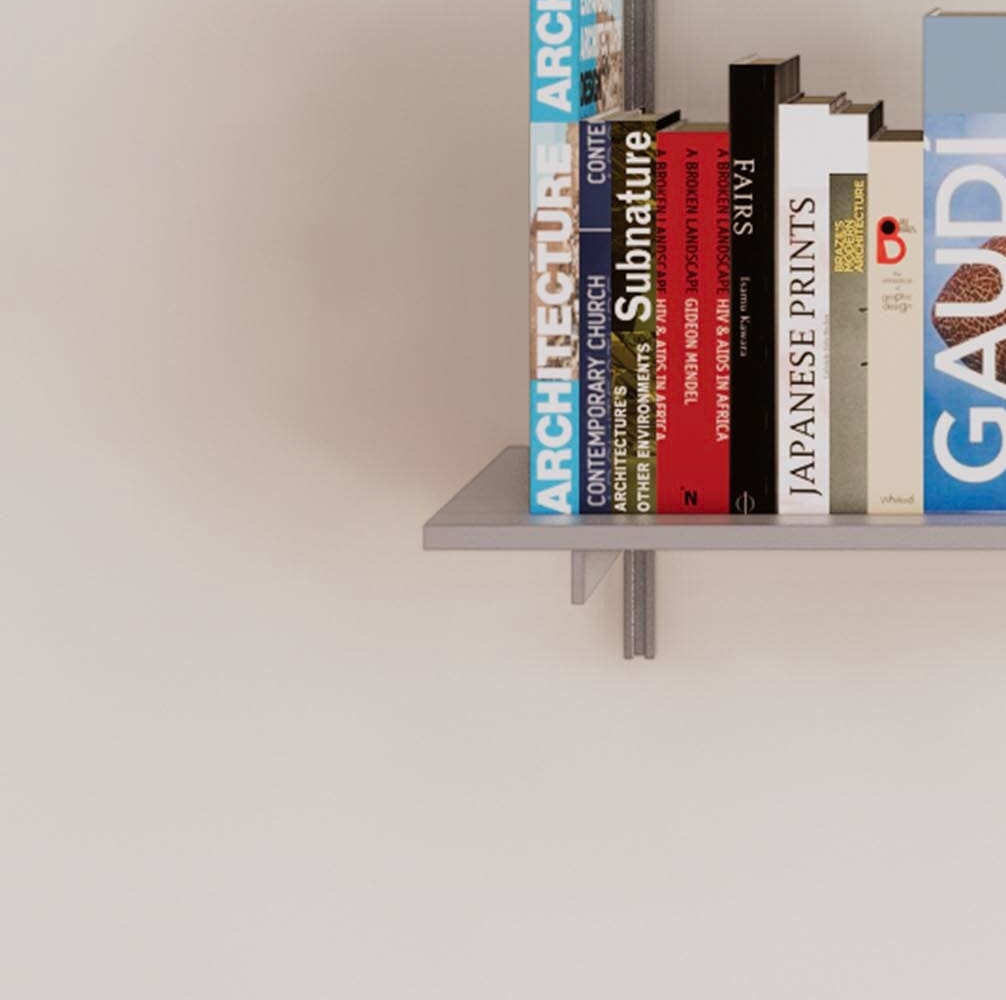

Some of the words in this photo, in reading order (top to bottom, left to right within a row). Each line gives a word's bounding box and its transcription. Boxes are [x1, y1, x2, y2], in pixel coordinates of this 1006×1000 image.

[586, 120, 607, 185] CONTE
[685, 148, 699, 158] A
[716, 148, 730, 158] A
[656, 162, 667, 214] BROKEN
[685, 162, 699, 214] BROKEN
[716, 162, 730, 214] BROKEN
[733, 158, 755, 236] FAIRS
[614, 130, 652, 323] Subnature
[685, 218, 699, 294] LANDSCAPE
[716, 218, 730, 294] LANDSCAPE
[853, 179, 865, 274] ARCHITECTURE
[789, 196, 816, 319] PRINTS
[536, 143, 574, 515] ARCHITECTURE
[586, 274, 606, 350] CHURCH
[684, 298, 699, 349] GIDEON
[716, 299, 730, 323] HIV
[716, 326, 730, 336] &
[684, 352, 699, 406] MENDEL
[716, 340, 730, 372] AIDS
[716, 376, 730, 390] IN
[636, 341, 651, 459] ENVIRONMENTS
[716, 394, 730, 442] AFRICA
[789, 329, 822, 497] JAPANESE
[586, 357, 606, 507] CONTEMPORARY
[613, 384, 628, 513] ARCHITECTURE'S
[636, 463, 651, 513] OTHER
